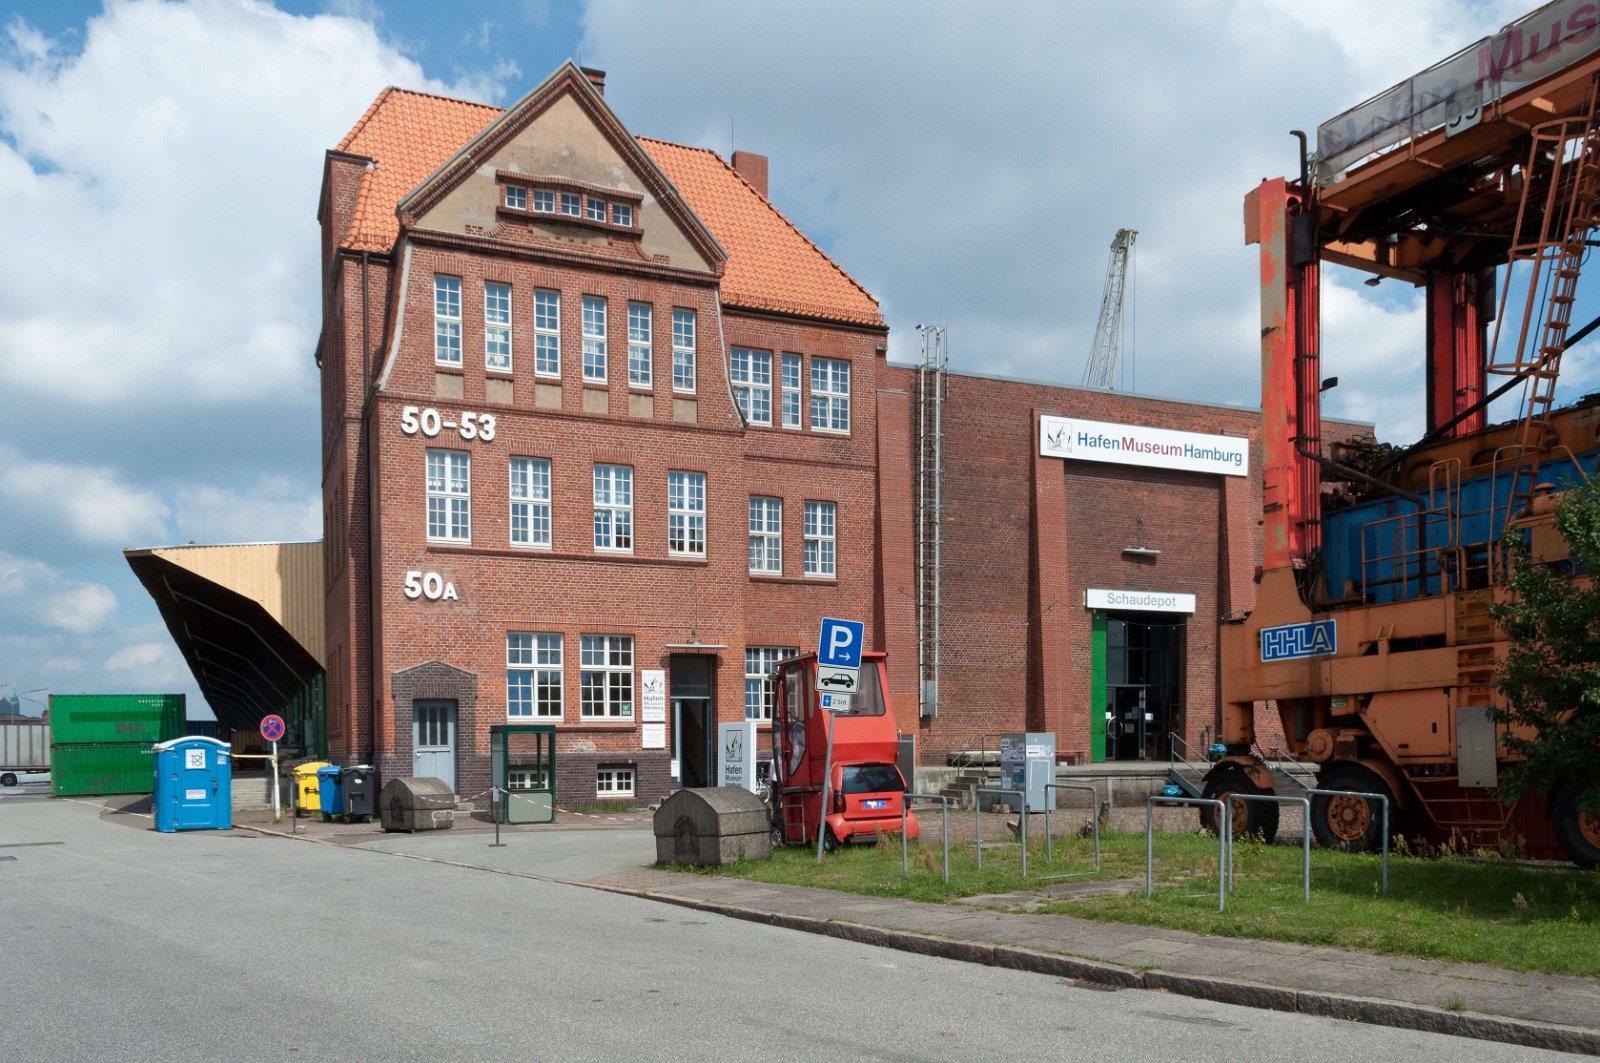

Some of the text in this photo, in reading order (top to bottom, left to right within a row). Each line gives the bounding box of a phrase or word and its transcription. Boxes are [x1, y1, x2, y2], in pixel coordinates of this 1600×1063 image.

[400, 406, 497, 441] 50-53
[404, 571, 458, 601] 50A
[1107, 592, 1177, 609] Schaudepot
[828, 625, 854, 660] P
[1264, 625, 1333, 658] HHLA
[725, 765, 743, 775] Hafen
